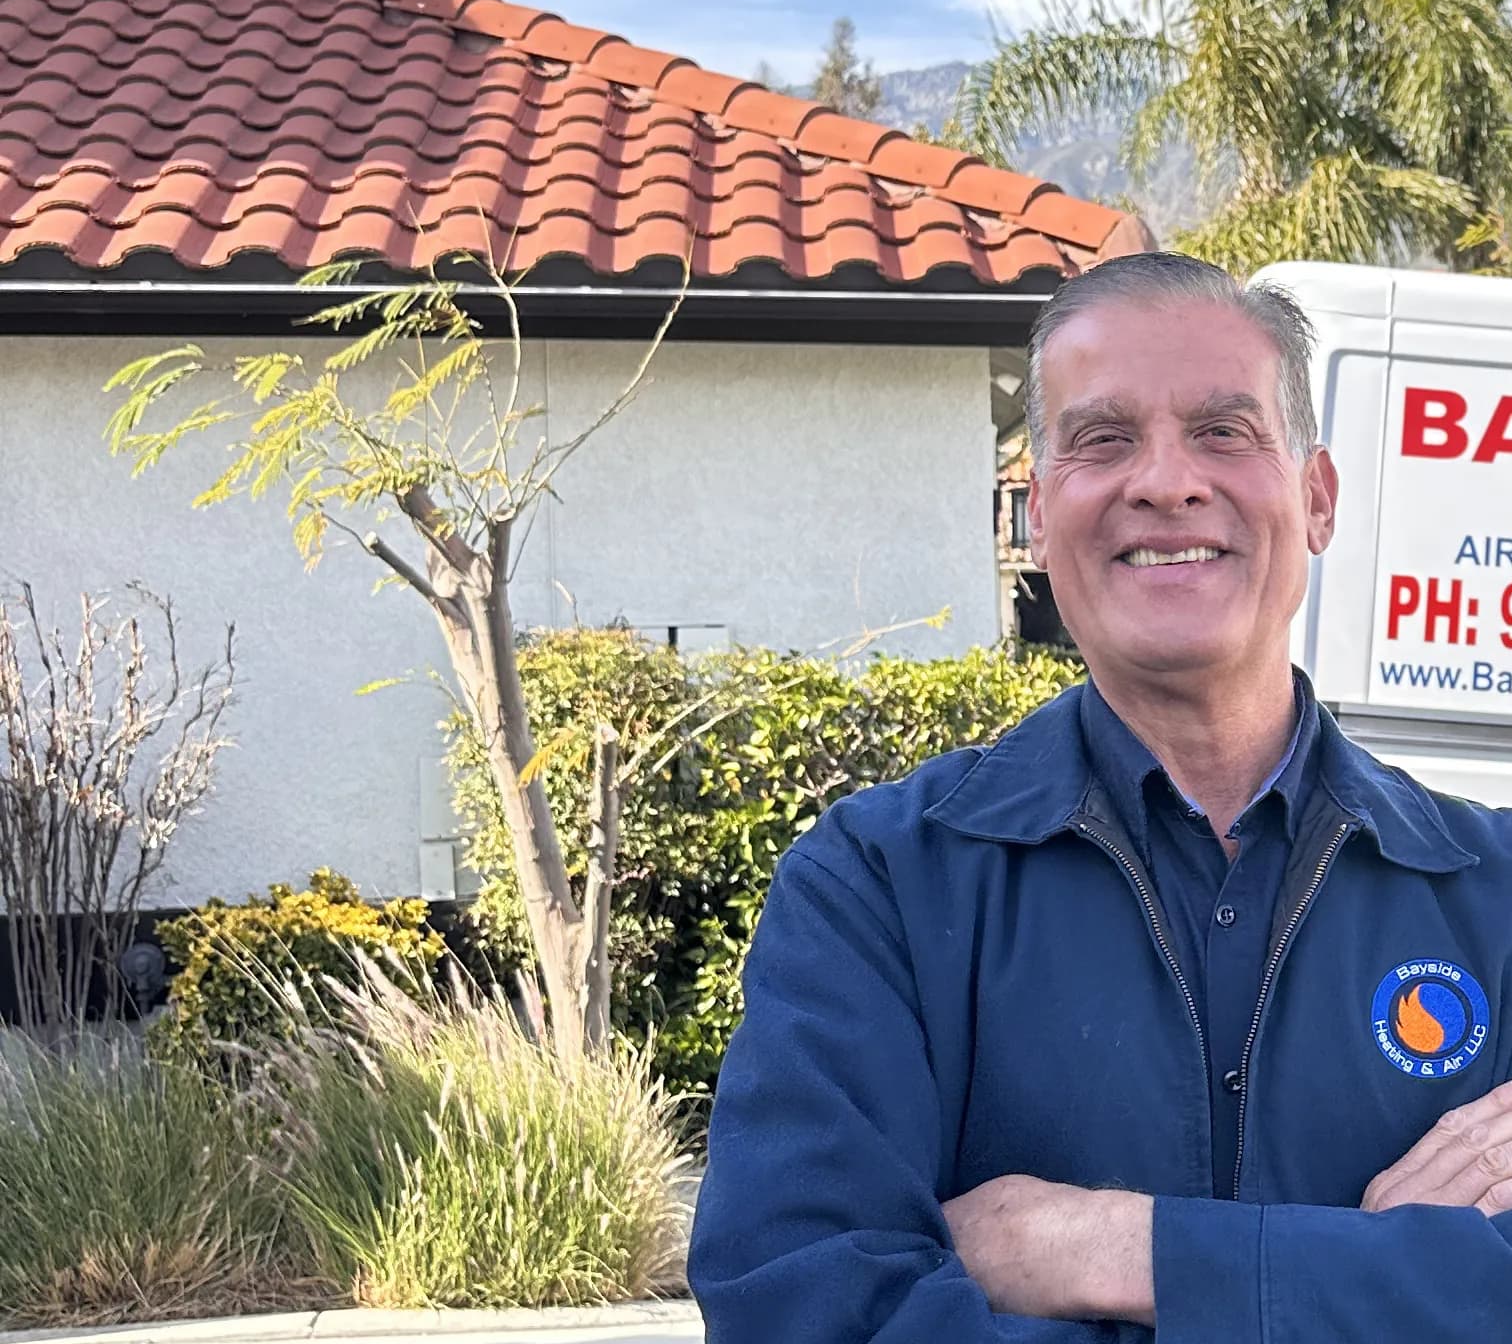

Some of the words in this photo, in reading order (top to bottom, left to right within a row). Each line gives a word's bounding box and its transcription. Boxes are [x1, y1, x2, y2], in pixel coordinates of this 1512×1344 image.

[1387, 574, 1479, 646] PH:
[1396, 963, 1461, 981] Bayside
[1374, 1020, 1414, 1072] Heating
[1421, 1062, 1434, 1074] &
[1443, 1055, 1464, 1073] Air
[1465, 1024, 1486, 1055] LLC
